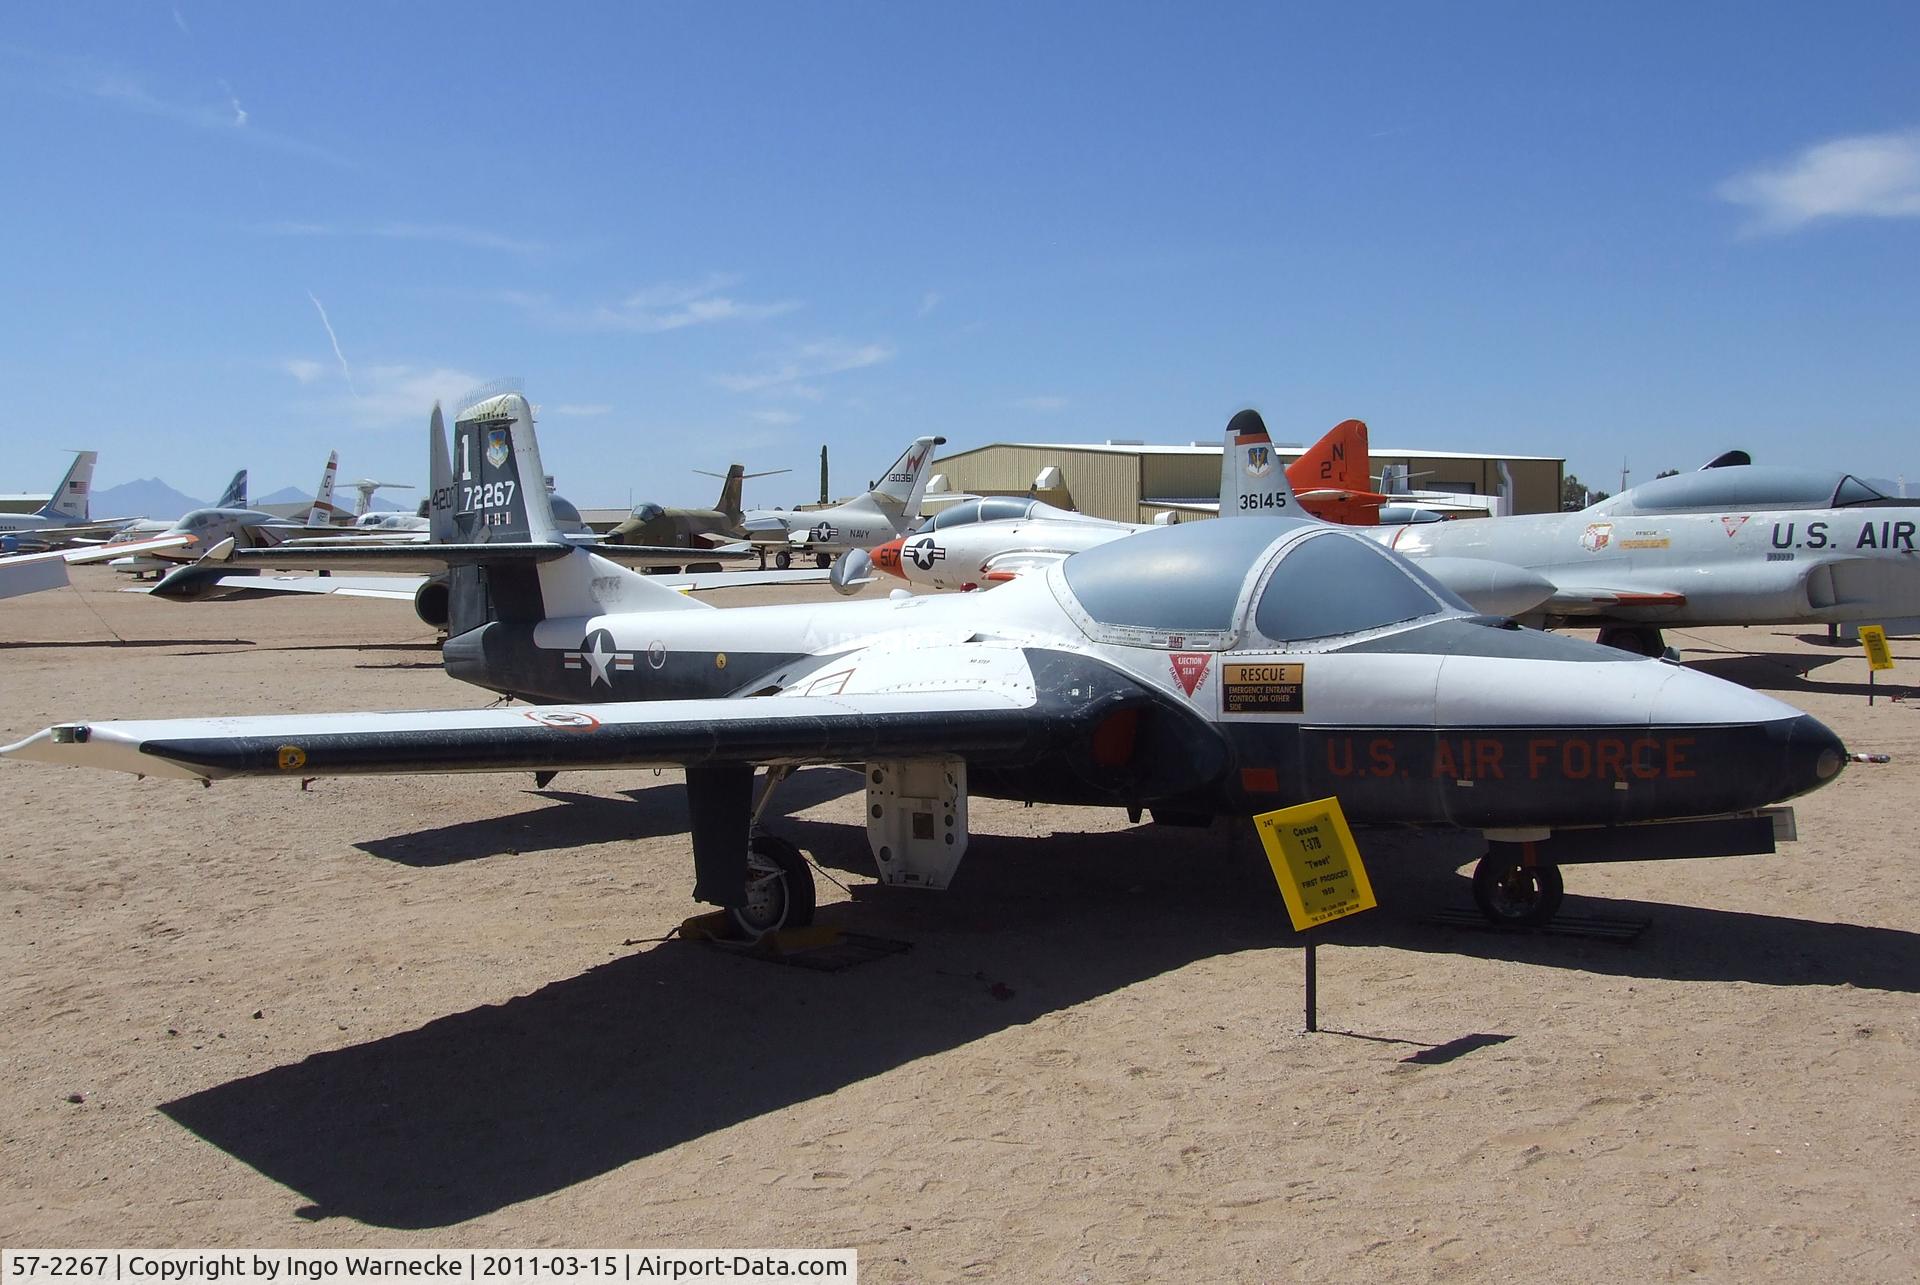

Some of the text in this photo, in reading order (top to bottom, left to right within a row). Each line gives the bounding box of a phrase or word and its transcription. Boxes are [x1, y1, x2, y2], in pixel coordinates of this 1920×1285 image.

[461, 434, 472, 481] 1
[905, 447, 928, 473] W
[1332, 443, 1344, 462] N
[1320, 461, 1332, 479] 2
[463, 480, 515, 511] 72267
[1239, 492, 1287, 510] 36145
[849, 529, 870, 538] NAVY
[1770, 521, 1916, 550] U.S. AIR
[880, 548, 902, 567] 517
[1178, 657, 1202, 665] EJECTION
[1169, 667, 1182, 690] DANGER
[1182, 667, 1195, 675] SEAT
[1197, 668, 1210, 691] DANGER
[1240, 668, 1286, 682] RESCUE
[1229, 686, 1296, 694] EMERGENCY ENTRANCE
[1229, 694, 1257, 702] CONTROL
[1229, 703, 1242, 711] SIDE
[1326, 737, 1697, 780] U.S. AIR FORCE
[1293, 824, 1318, 837] Cessna
[1300, 836, 1322, 852] T-37B
[1302, 869, 1349, 888] FIRST PRODUCED
